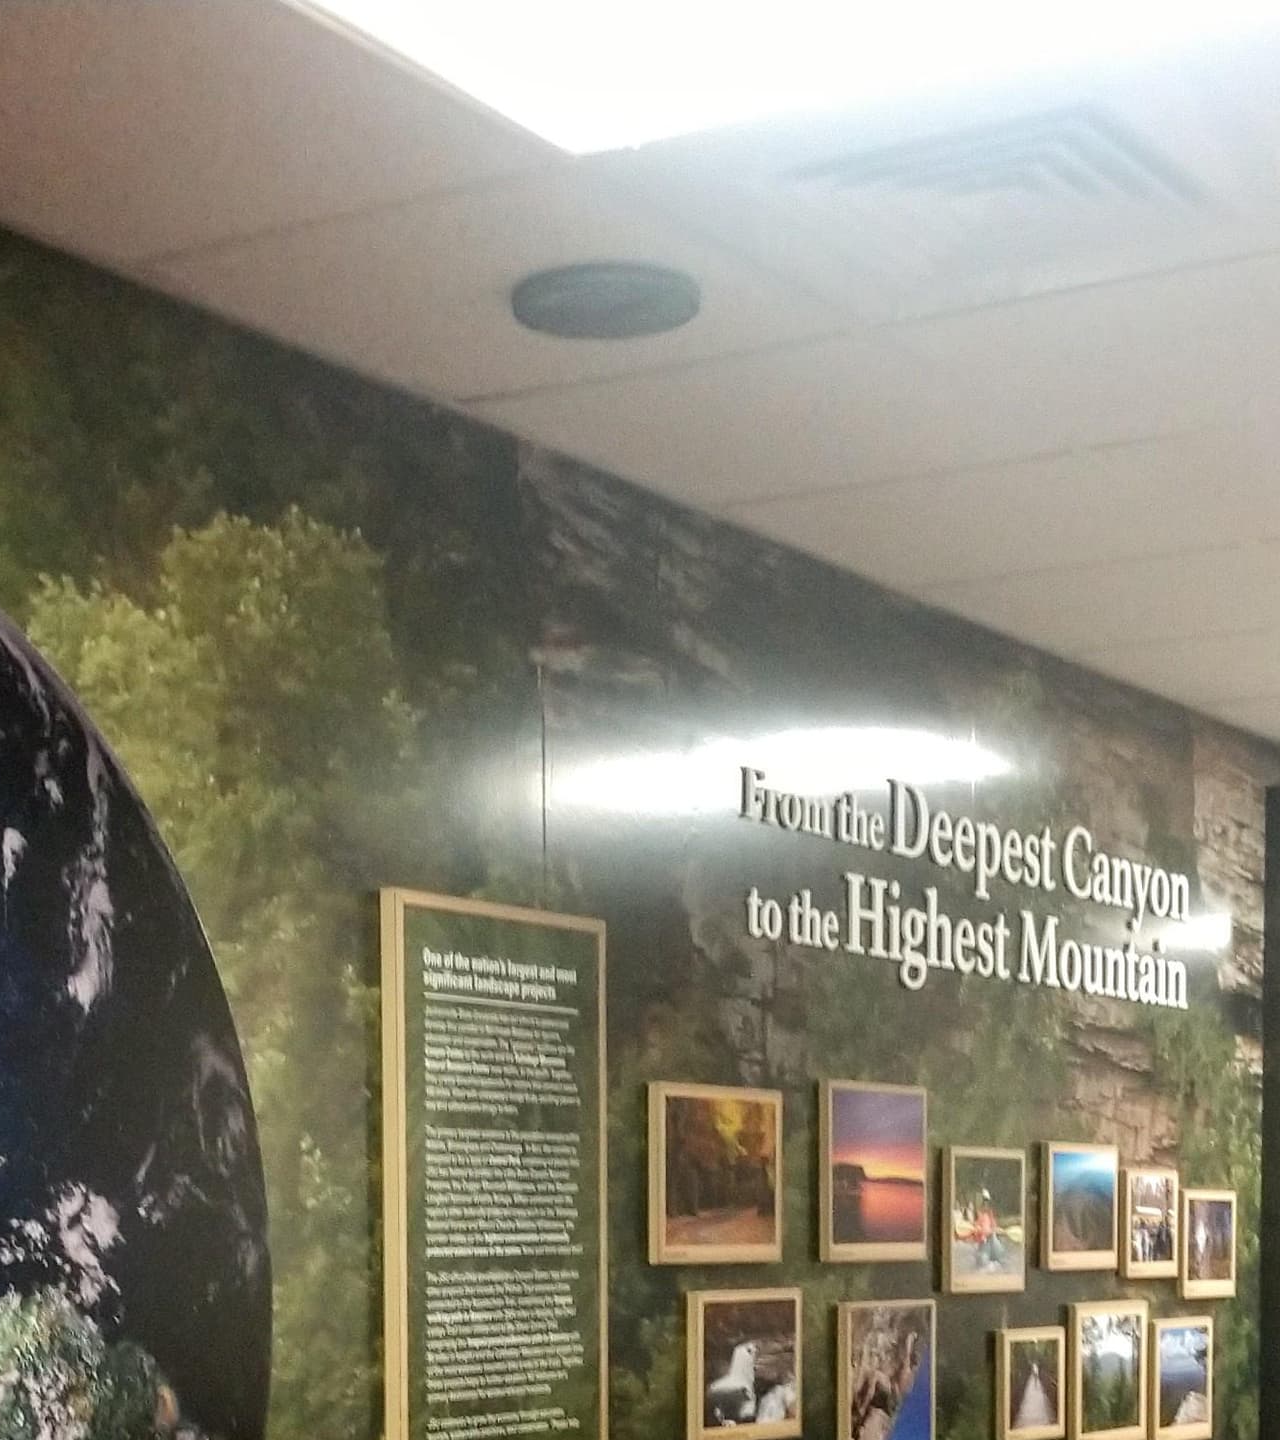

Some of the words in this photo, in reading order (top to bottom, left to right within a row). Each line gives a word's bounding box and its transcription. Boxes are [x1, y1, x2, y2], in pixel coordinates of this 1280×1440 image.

[739, 766, 833, 838] From
[835, 791, 885, 850] the
[887, 778, 1056, 900] Deepest
[1064, 824, 1191, 931] Canyon
[422, 947, 442, 968] One
[443, 951, 454, 968] of
[454, 952, 470, 971] the
[746, 886, 783, 940] to
[788, 888, 840, 951] the
[844, 871, 1011, 991] Highest
[1018, 910, 1189, 1010] Mountain
